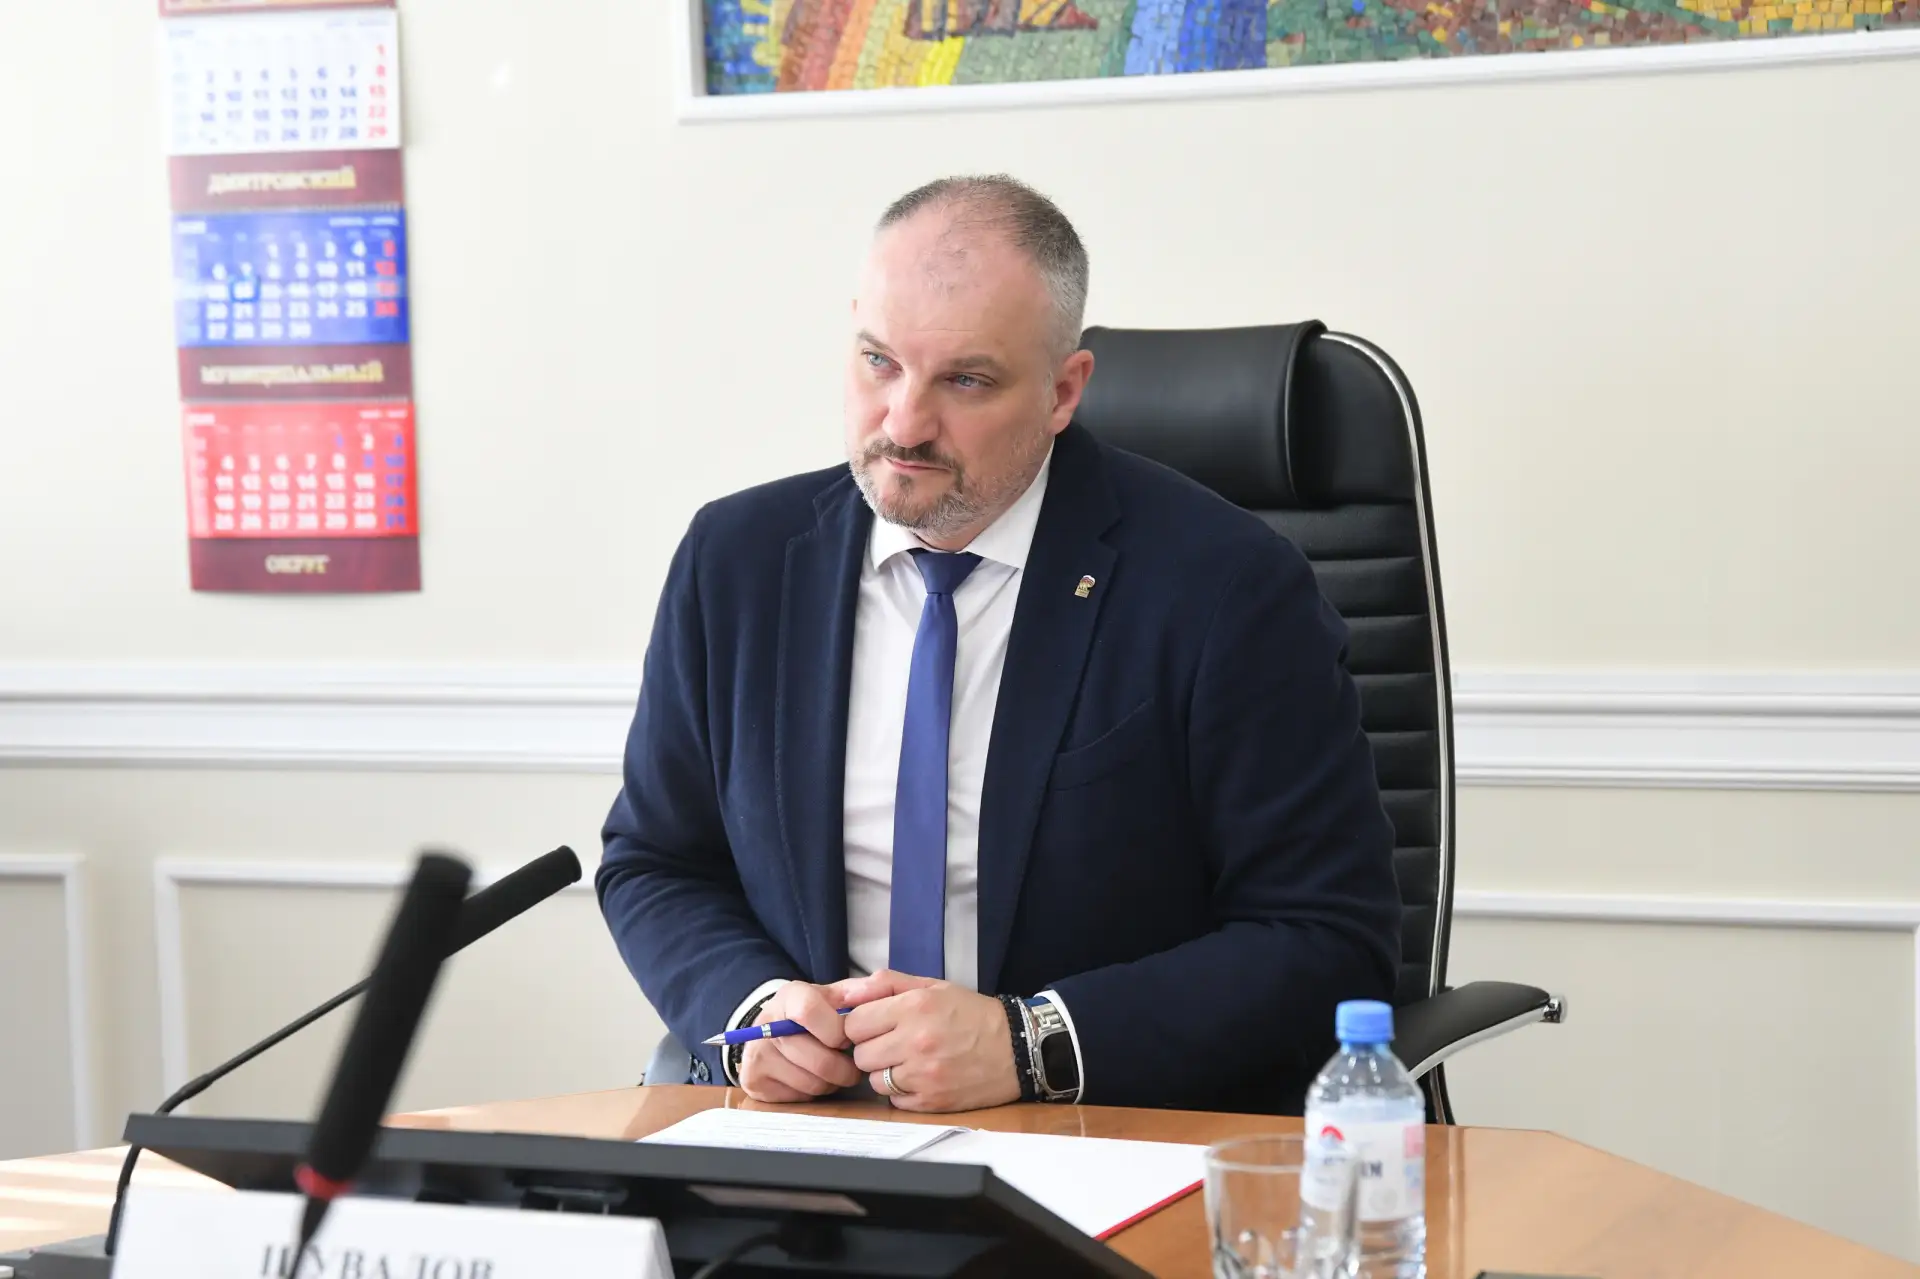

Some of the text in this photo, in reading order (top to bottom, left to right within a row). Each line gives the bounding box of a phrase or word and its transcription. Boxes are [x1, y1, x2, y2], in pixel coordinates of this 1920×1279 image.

[206, 165, 356, 195] ДМИТРОВСКИЙ
[201, 360, 384, 388] МУНИЦИПАЛЬНЫЙ
[264, 554, 331, 574] ОКРУГ
